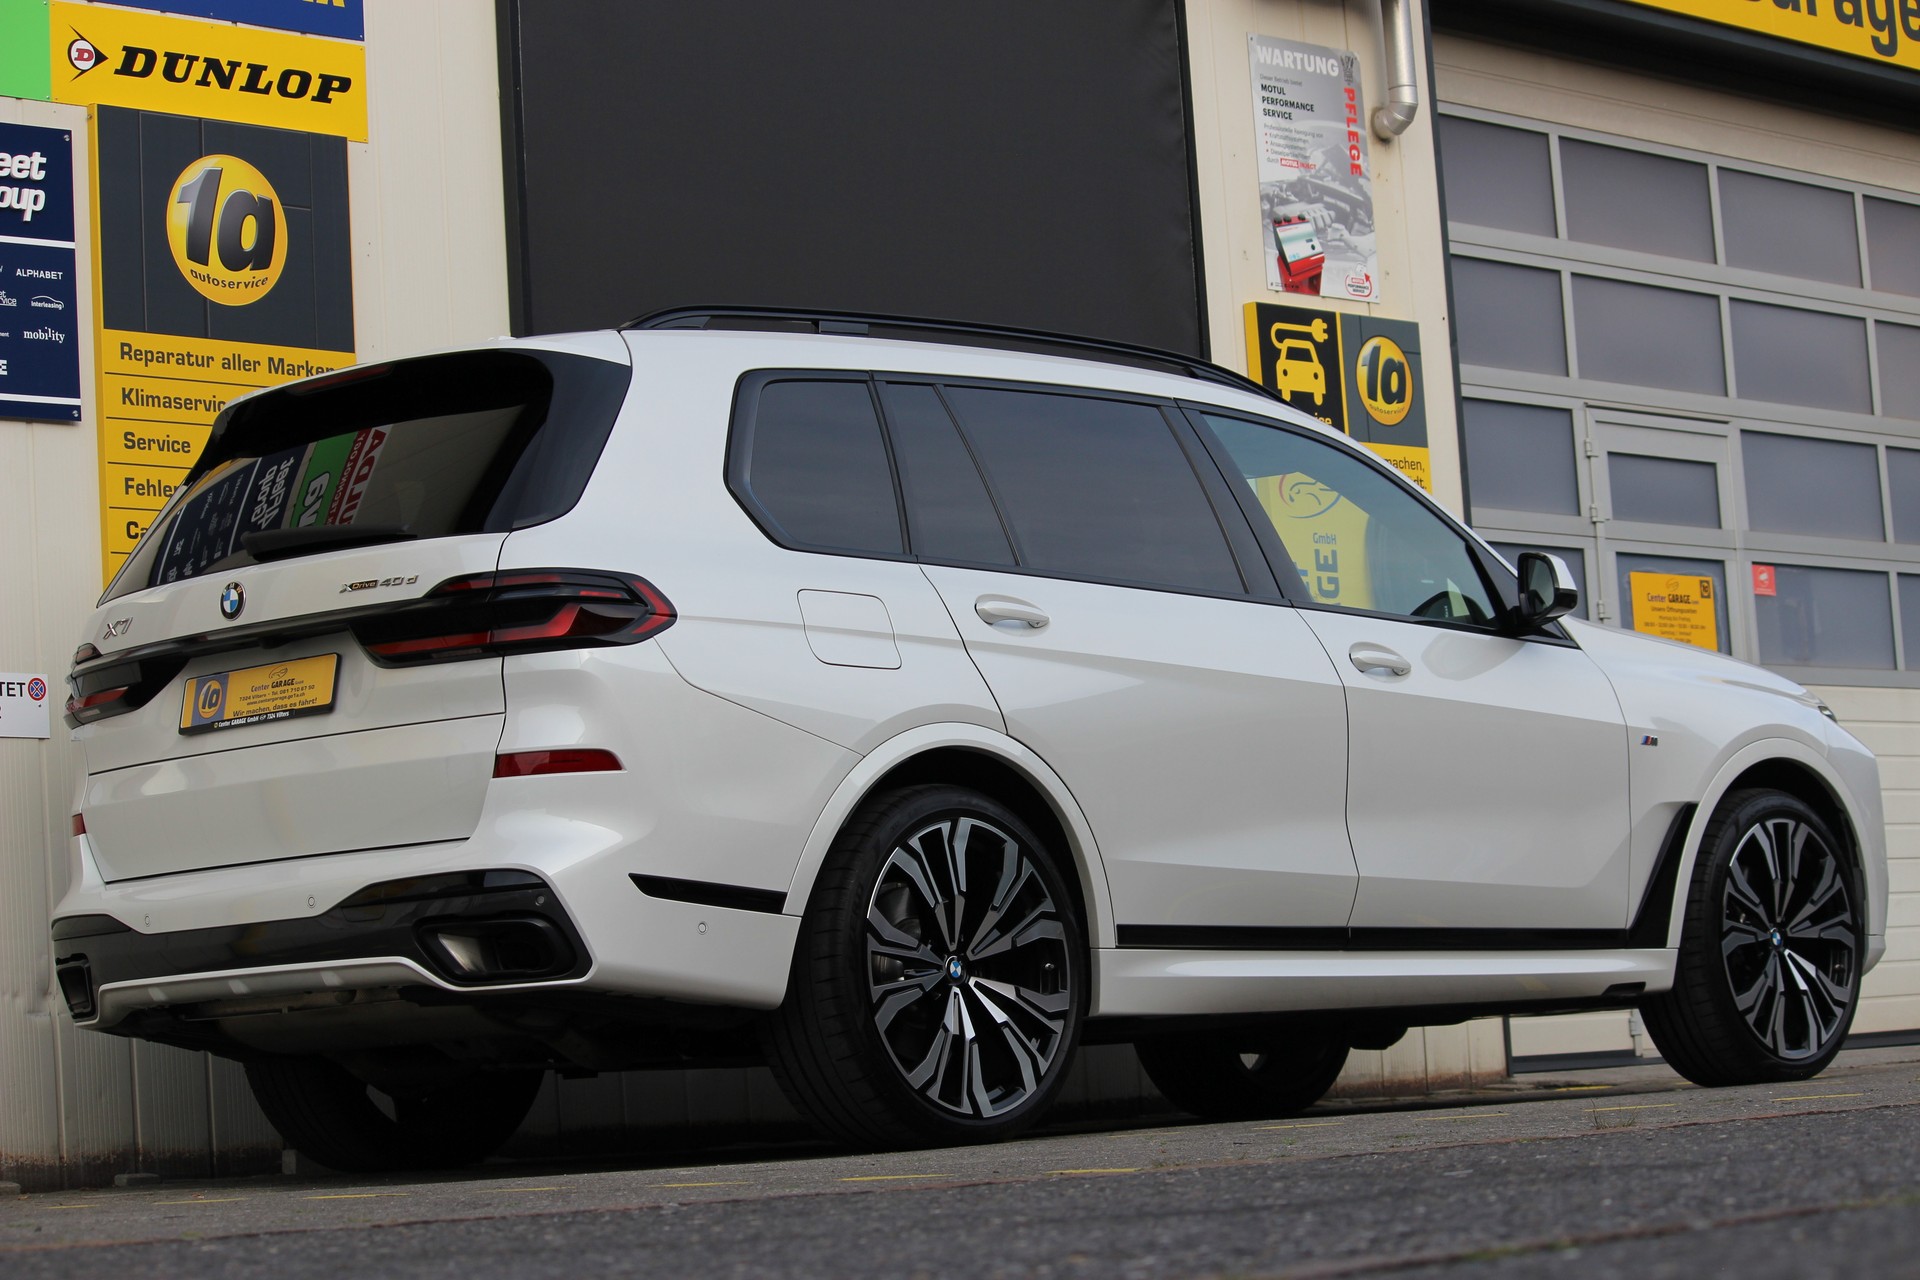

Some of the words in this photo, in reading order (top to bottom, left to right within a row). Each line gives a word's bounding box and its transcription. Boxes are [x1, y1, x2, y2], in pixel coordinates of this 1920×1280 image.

[1257, 46, 1339, 77] WARTUNG
[114, 45, 352, 104] DUNLOP
[1261, 83, 1286, 96] MOTUL
[1262, 96, 1315, 113] PERFORMANCE
[1263, 108, 1293, 120] SERVICE
[1343, 87, 1363, 177] PFLEGE
[177, 167, 276, 271] 1a
[16, 268, 63, 280] ALPHABET
[190, 269, 269, 289] autoservice
[31, 301, 62, 310] Interleasing
[24, 326, 65, 343] mobility
[120, 342, 215, 368] Reparatur
[222, 349, 261, 373] aller
[1362, 345, 1407, 404] 1a
[123, 431, 191, 454] Service
[1313, 532, 1337, 545] GmbH
[1314, 548, 1340, 605] GE
[1668, 593, 1691, 604] GARAGE
[103, 617, 133, 640] X7
[0, 682, 26, 697] TET
[251, 683, 269, 692] Center
[271, 678, 295, 689] GARAGE
[201, 685, 221, 710] 1a
[232, 709, 244, 718] Wir
[246, 706, 271, 715] machen,
[272, 702, 287, 711] dass
[231, 717, 247, 725] GARAGE
